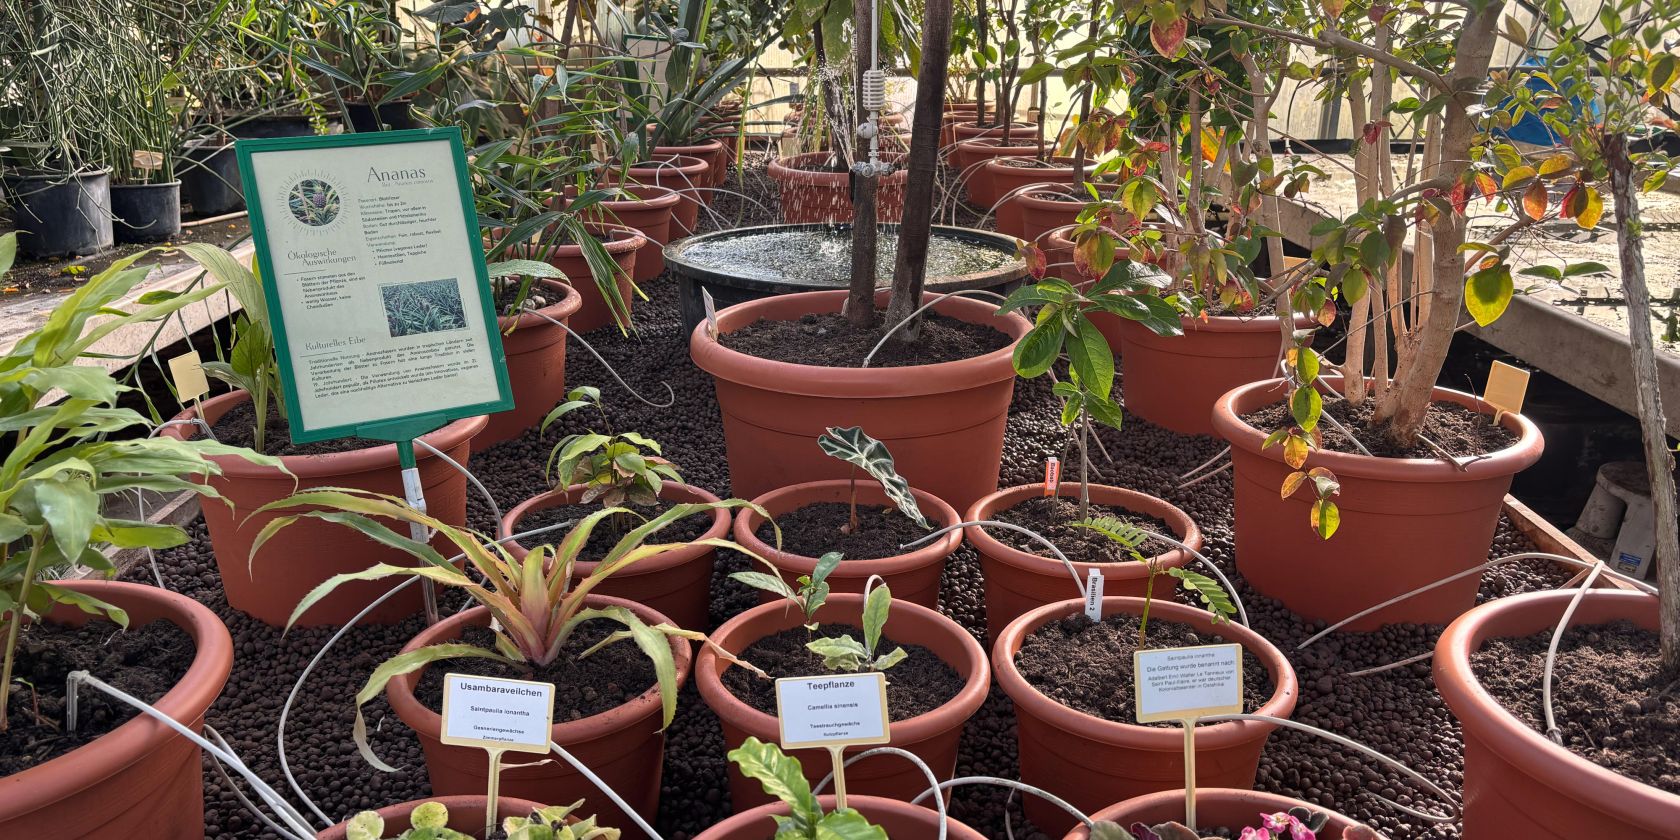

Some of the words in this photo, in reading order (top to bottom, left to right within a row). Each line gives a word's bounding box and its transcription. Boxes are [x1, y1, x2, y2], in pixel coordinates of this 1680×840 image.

[367, 166, 426, 183] Ananas
[288, 248, 337, 260] Ökologische
[302, 255, 357, 267] Auswirkungen
[305, 338, 347, 351] Kulturelles
[348, 336, 366, 345] Erbe
[1090, 576, 1098, 606] Brasilien
[460, 682, 542, 697] Usambaraveilchen
[807, 681, 855, 690] Teepflanze
[470, 706, 503, 714] Saintpaulia
[504, 708, 530, 716] ionantha
